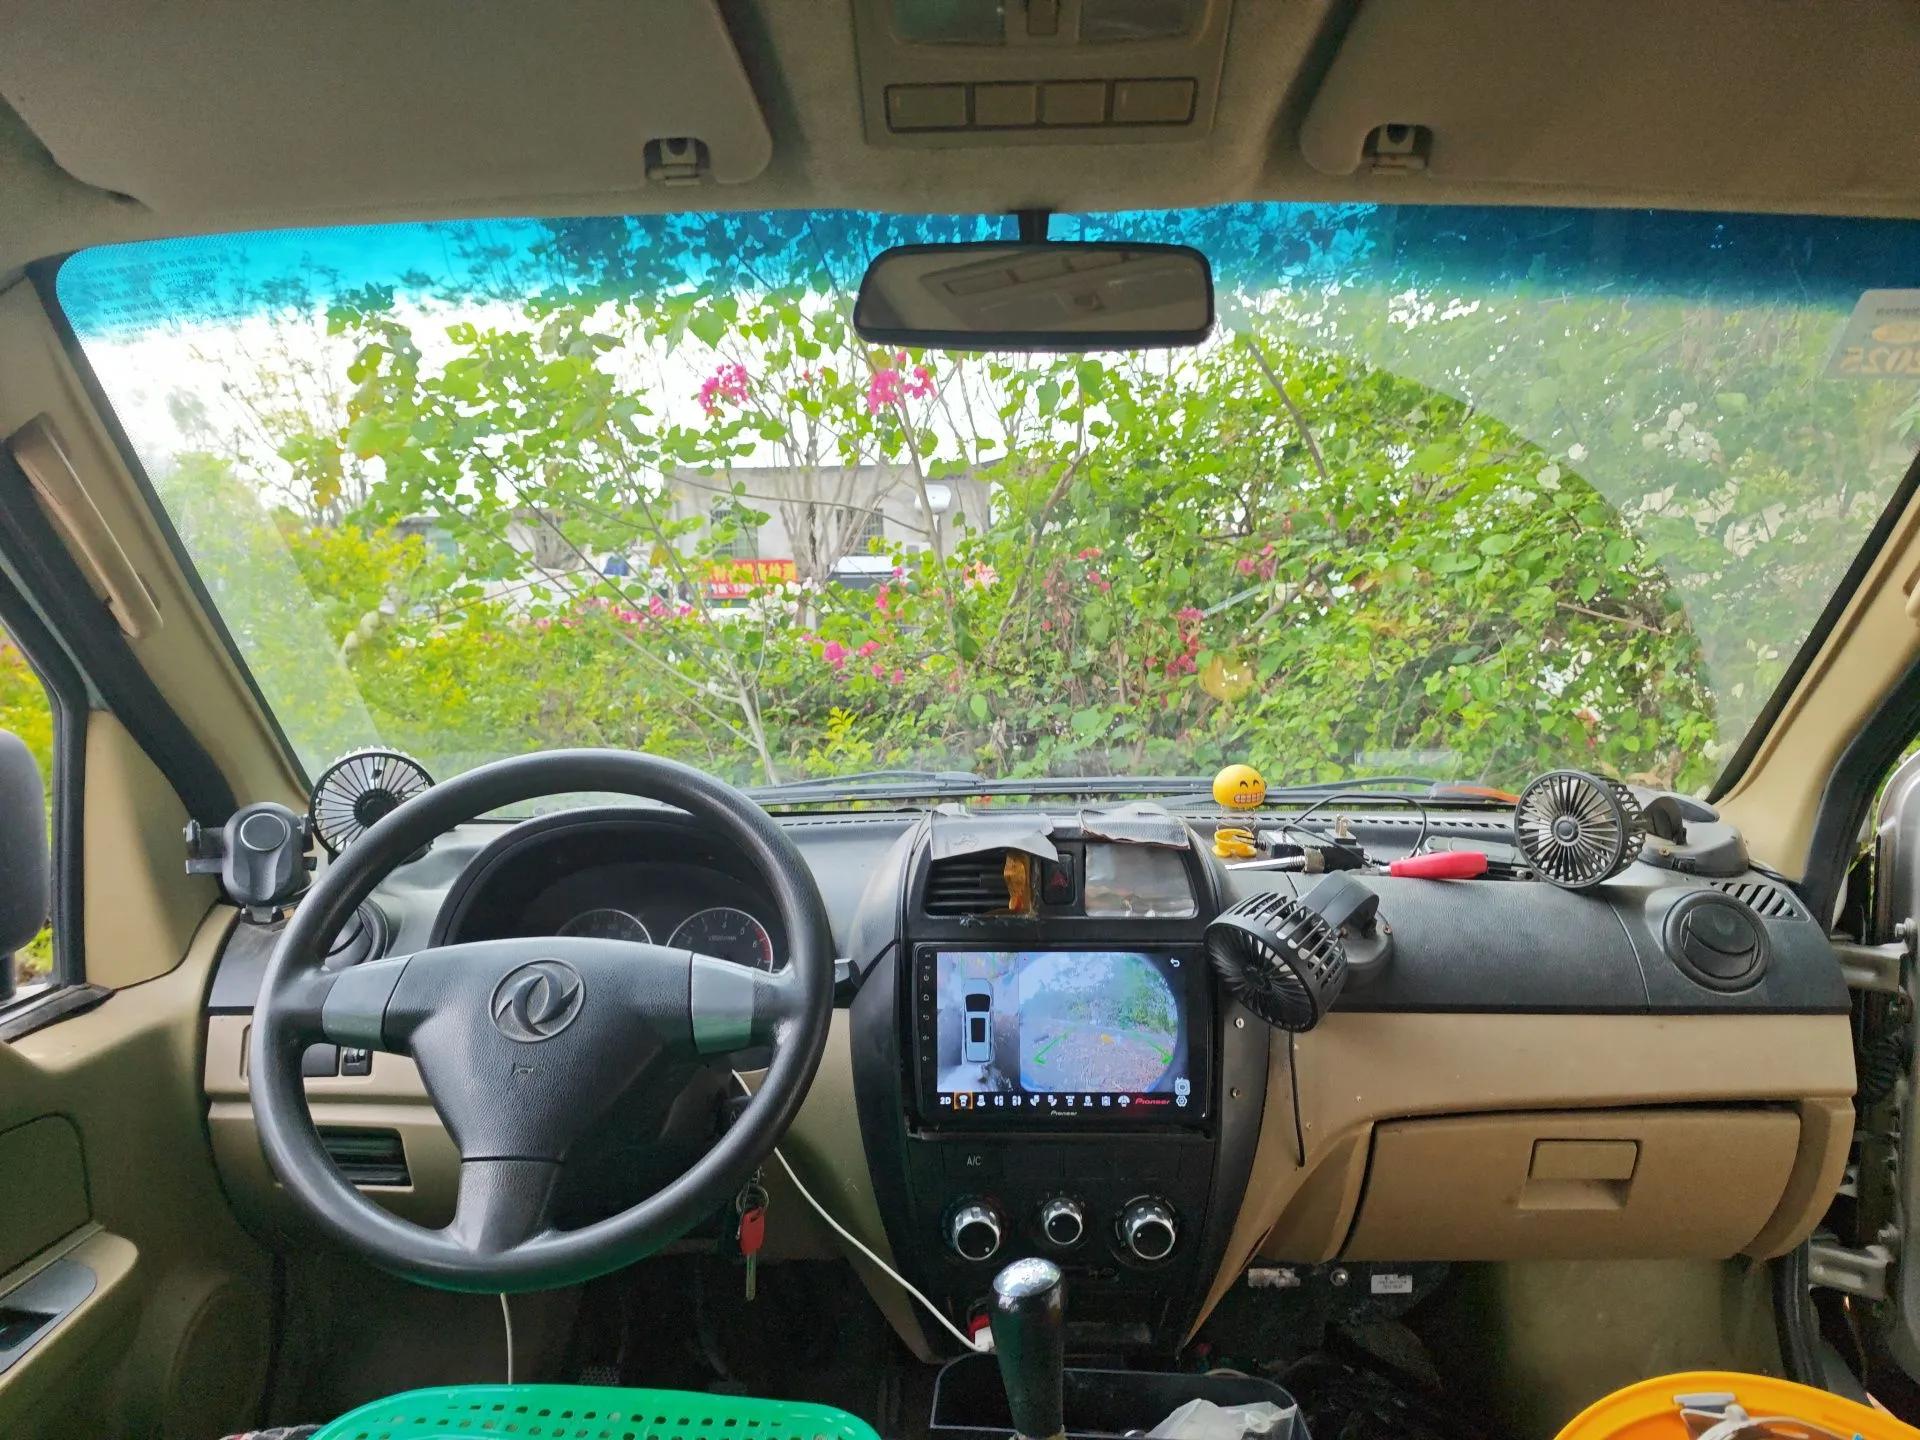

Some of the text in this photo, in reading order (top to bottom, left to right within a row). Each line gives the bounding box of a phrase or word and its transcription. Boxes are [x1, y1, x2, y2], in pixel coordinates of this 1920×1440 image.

[940, 1096, 952, 1105] 2D
[1135, 1097, 1170, 1105] Pioneer
[966, 1154, 981, 1167] A/C
